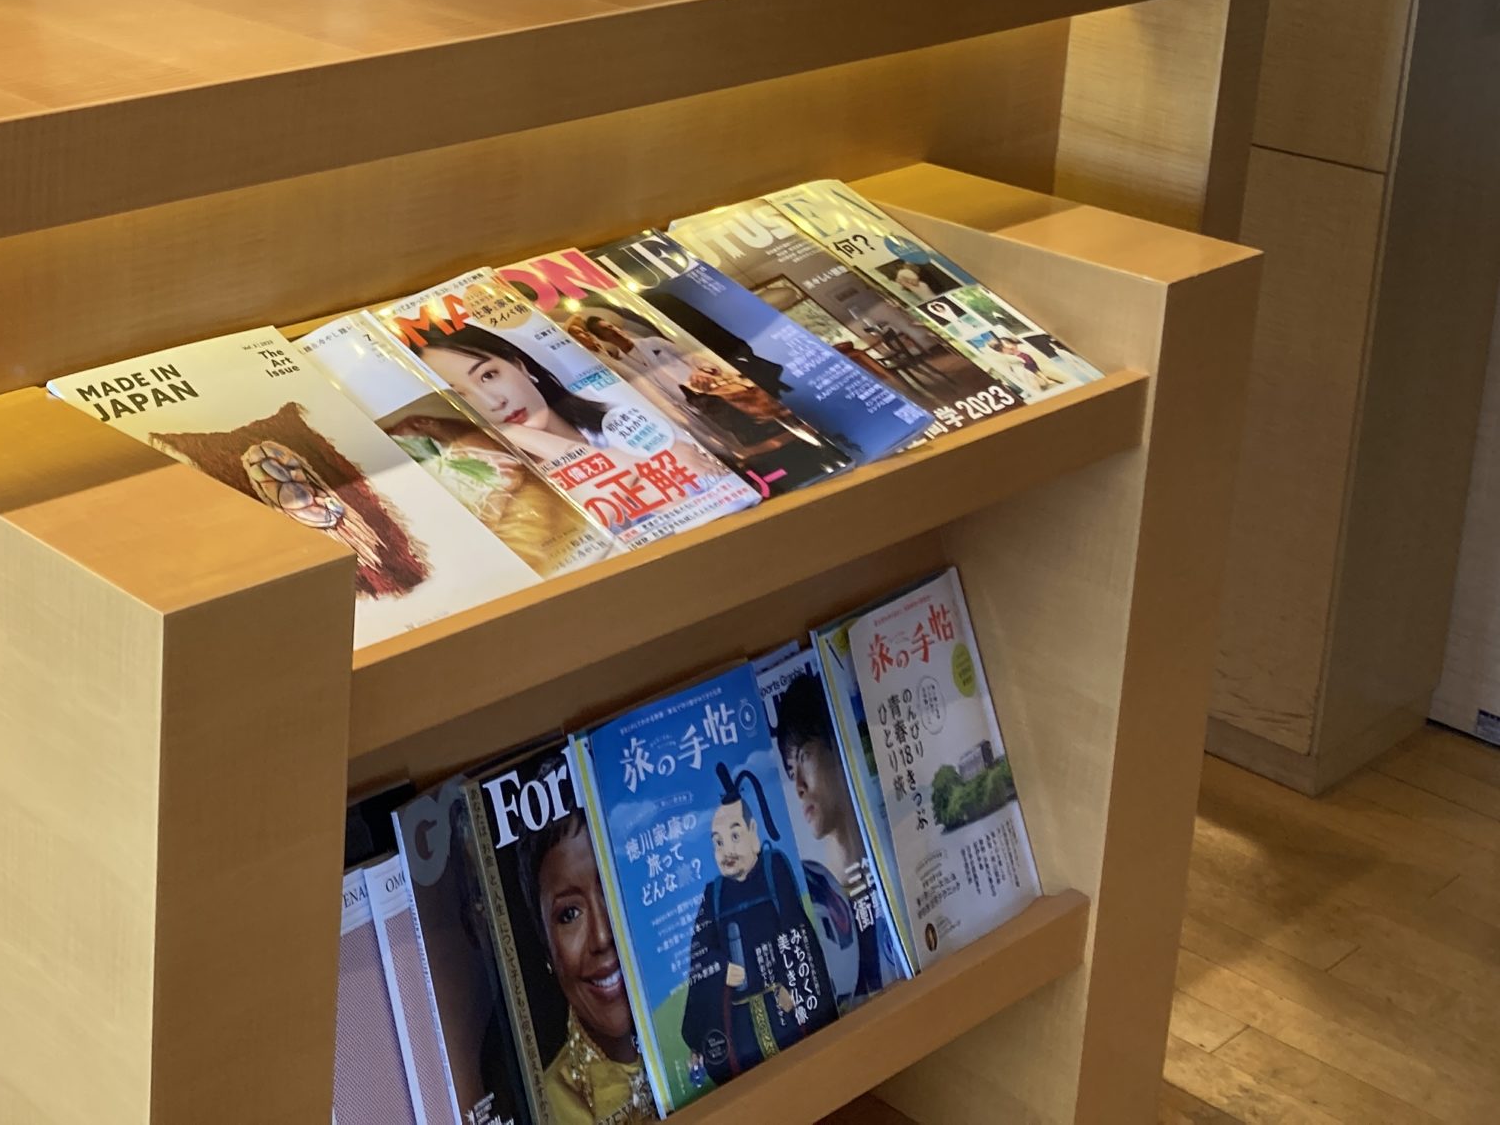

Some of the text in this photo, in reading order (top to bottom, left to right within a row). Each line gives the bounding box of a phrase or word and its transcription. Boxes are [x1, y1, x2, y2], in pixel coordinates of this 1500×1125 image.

[832, 234, 877, 260] 何?
[257, 349, 285, 360] The
[265, 365, 301, 378] Issue
[271, 356, 294, 368] Art
[76, 363, 183, 403] MADE IN
[93, 379, 200, 423] JAPAN
[907, 385, 1016, 450] 間学2023
[583, 448, 701, 529] の正解
[867, 602, 955, 684] 旅の手帖
[902, 688, 925, 758] のんびり
[619, 703, 739, 793] 旅の手帖
[624, 812, 698, 865] 徳川家康の
[645, 843, 684, 881] 旅って
[789, 927, 819, 1012] みちのくの
